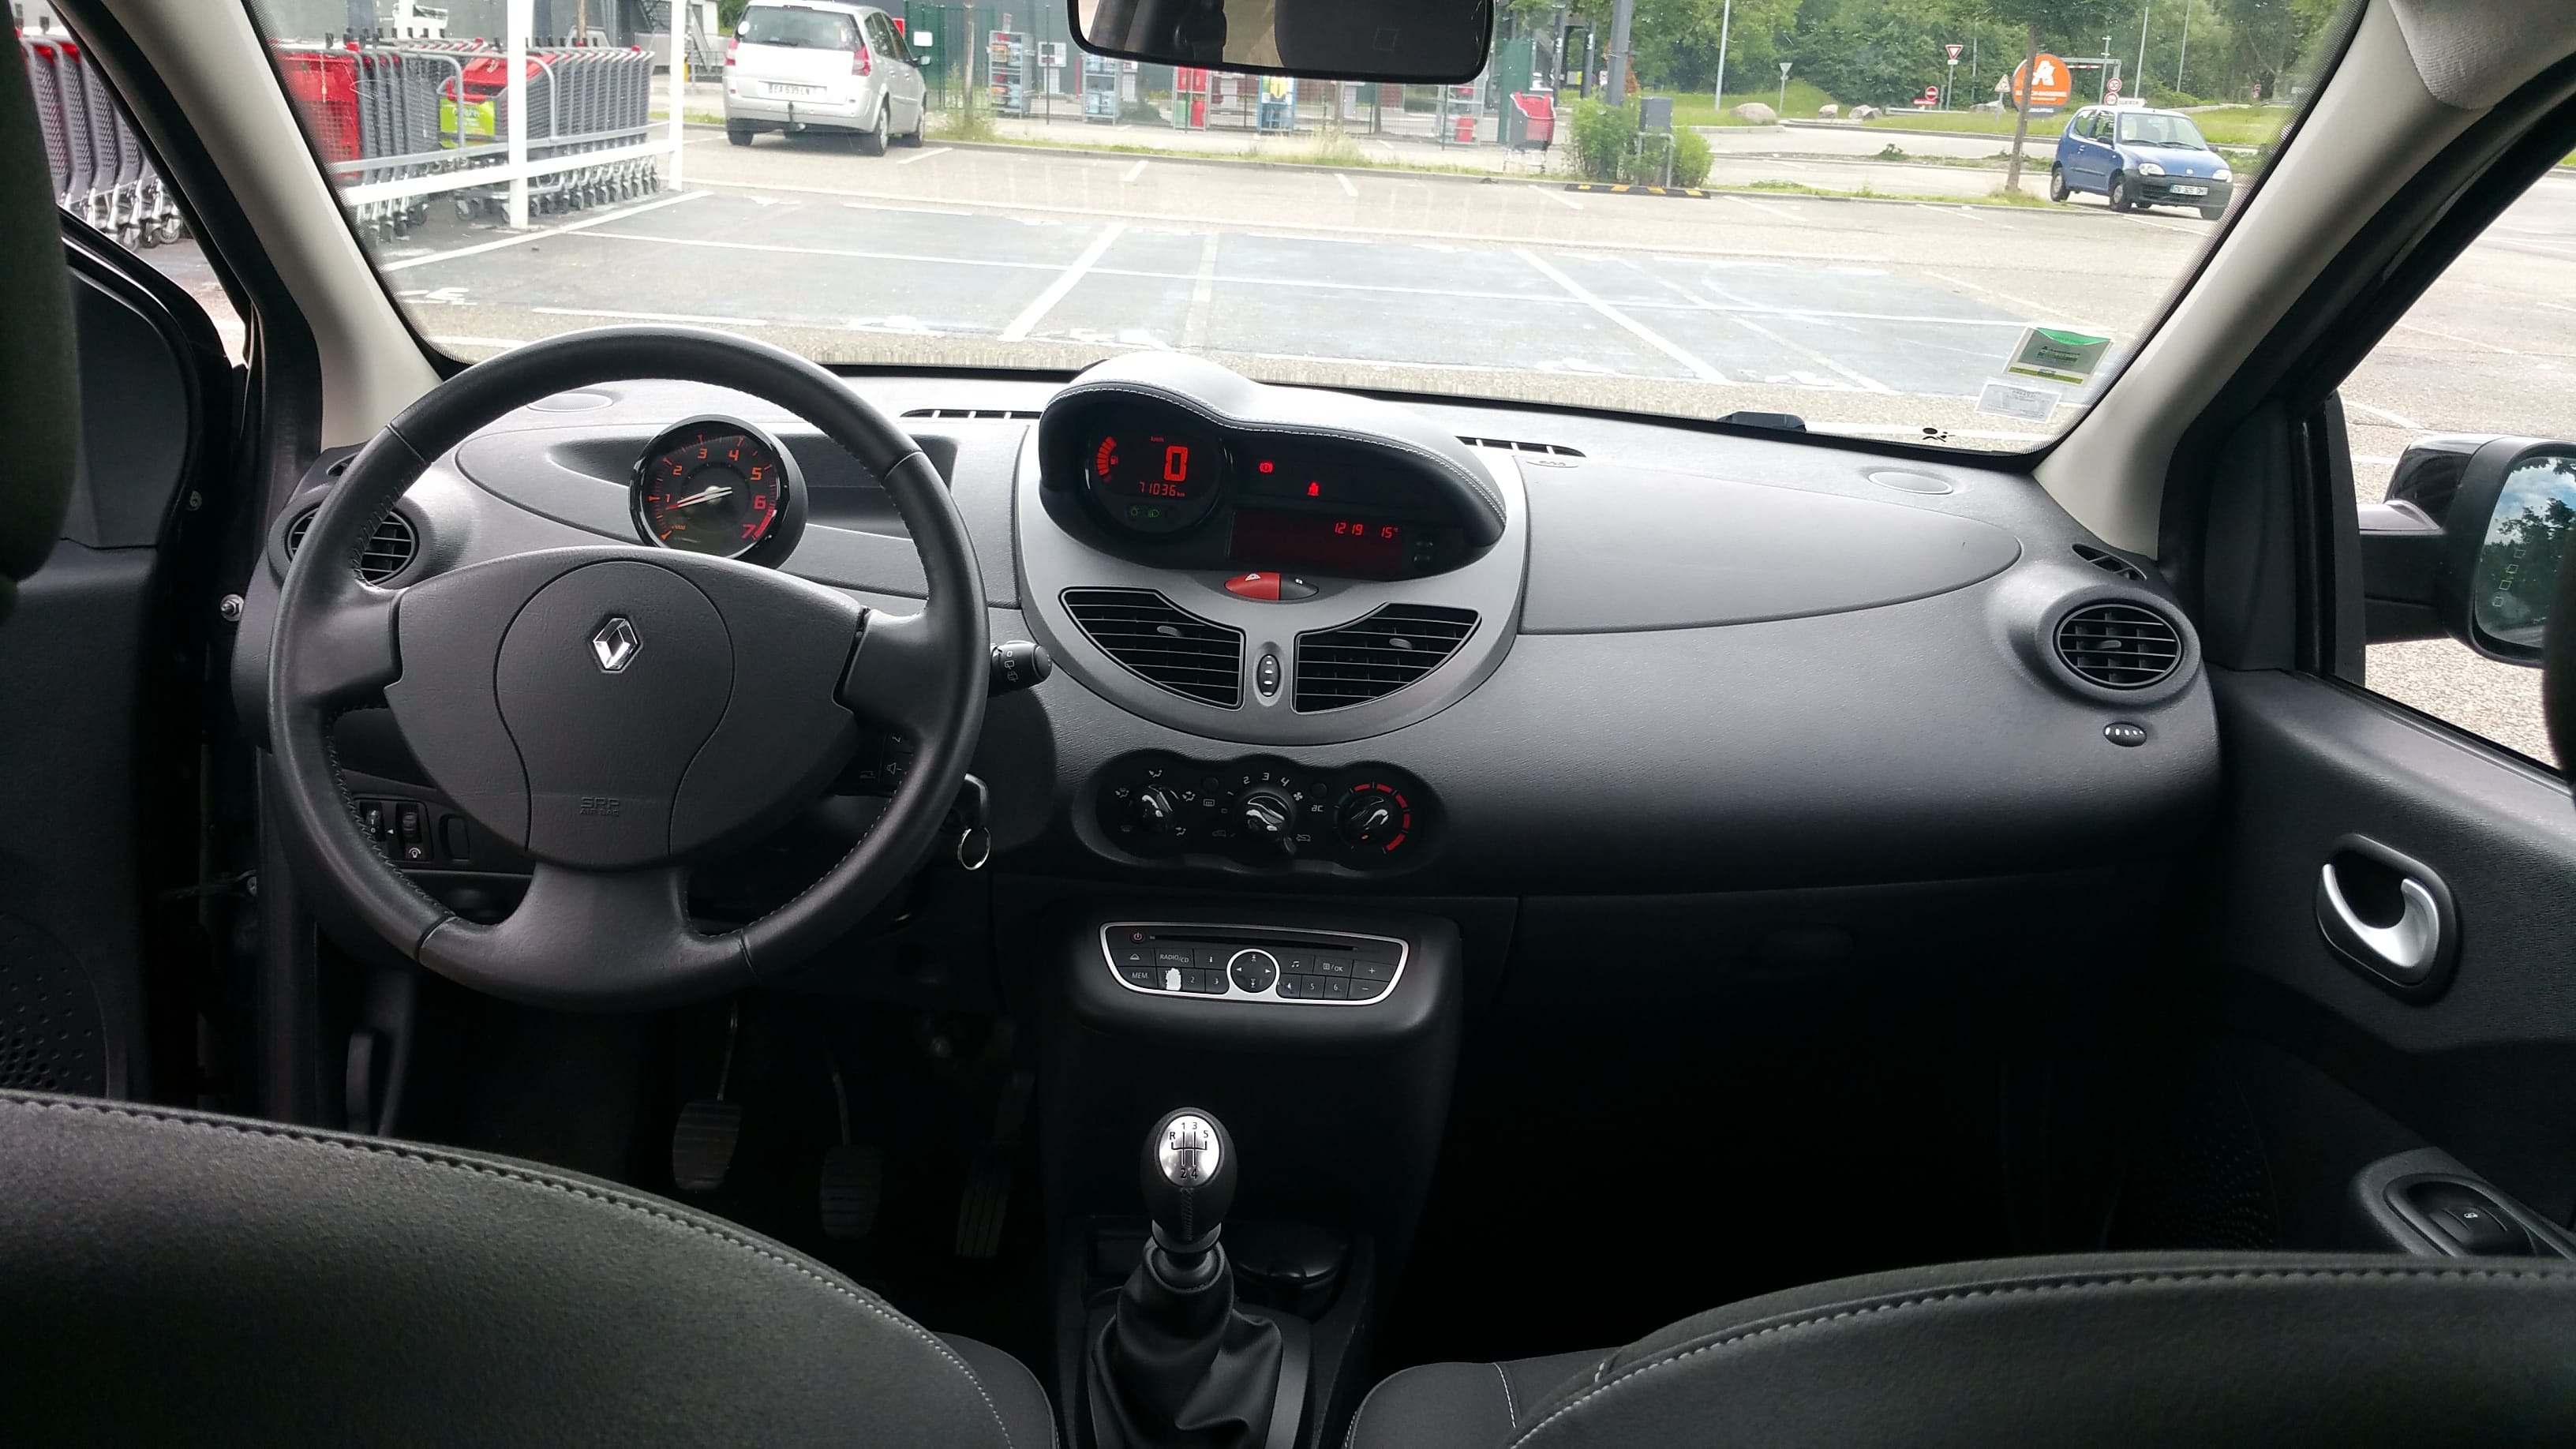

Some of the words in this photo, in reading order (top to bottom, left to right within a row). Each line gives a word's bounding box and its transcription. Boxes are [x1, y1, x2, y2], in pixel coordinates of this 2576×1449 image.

[697, 448, 707, 459] 3
[728, 449, 739, 461] 4
[1164, 446, 1188, 481] 0
[673, 466, 683, 476] 2
[751, 467, 762, 481] 5
[1140, 481, 1176, 496] 71036
[665, 493, 671, 503] 1
[754, 495, 766, 510] 6
[742, 524, 756, 539] 7
[1280, 777, 1290, 787] 4
[1159, 953, 1189, 964] RADIO/CD
[1192, 1121, 1198, 1130] 3
[1170, 1132, 1176, 1140] R
[1181, 1168, 1187, 1179] 2
[1191, 1168, 1198, 1179] 4
